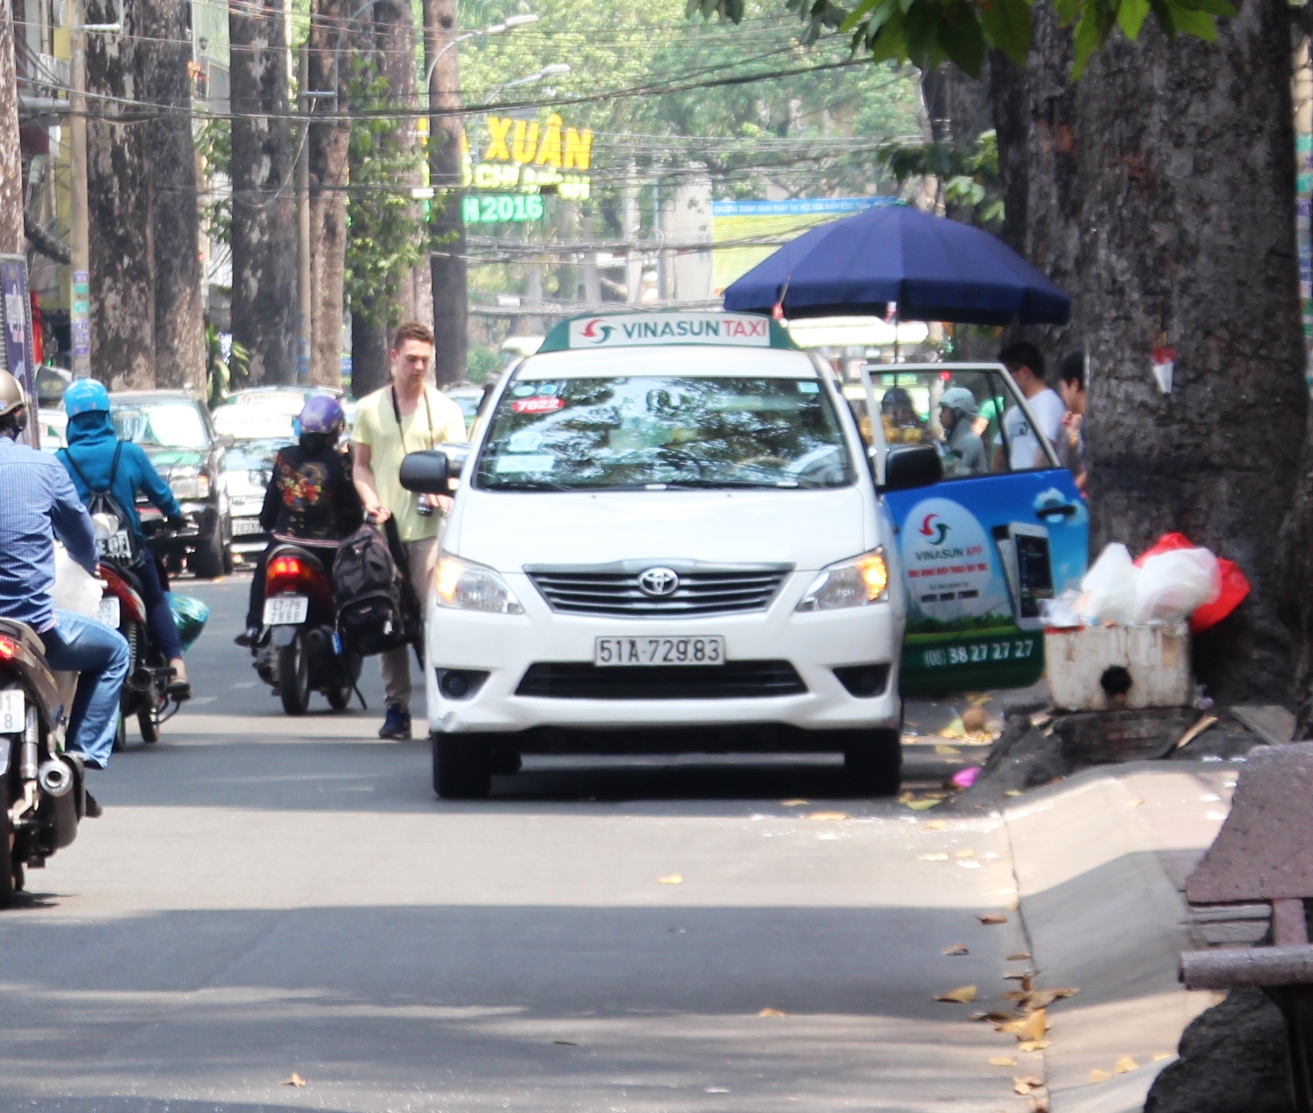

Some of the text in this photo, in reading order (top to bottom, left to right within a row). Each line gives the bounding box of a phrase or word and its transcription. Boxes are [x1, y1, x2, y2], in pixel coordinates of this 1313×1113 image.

[484, 113, 593, 172] XUÂN
[915, 548, 964, 561] VINASUN
[599, 638, 720, 663] 51A-729.83
[949, 646, 968, 665] 38
[970, 644, 987, 663] 27
[992, 641, 1011, 660] 27
[1014, 639, 1034, 658] 27
